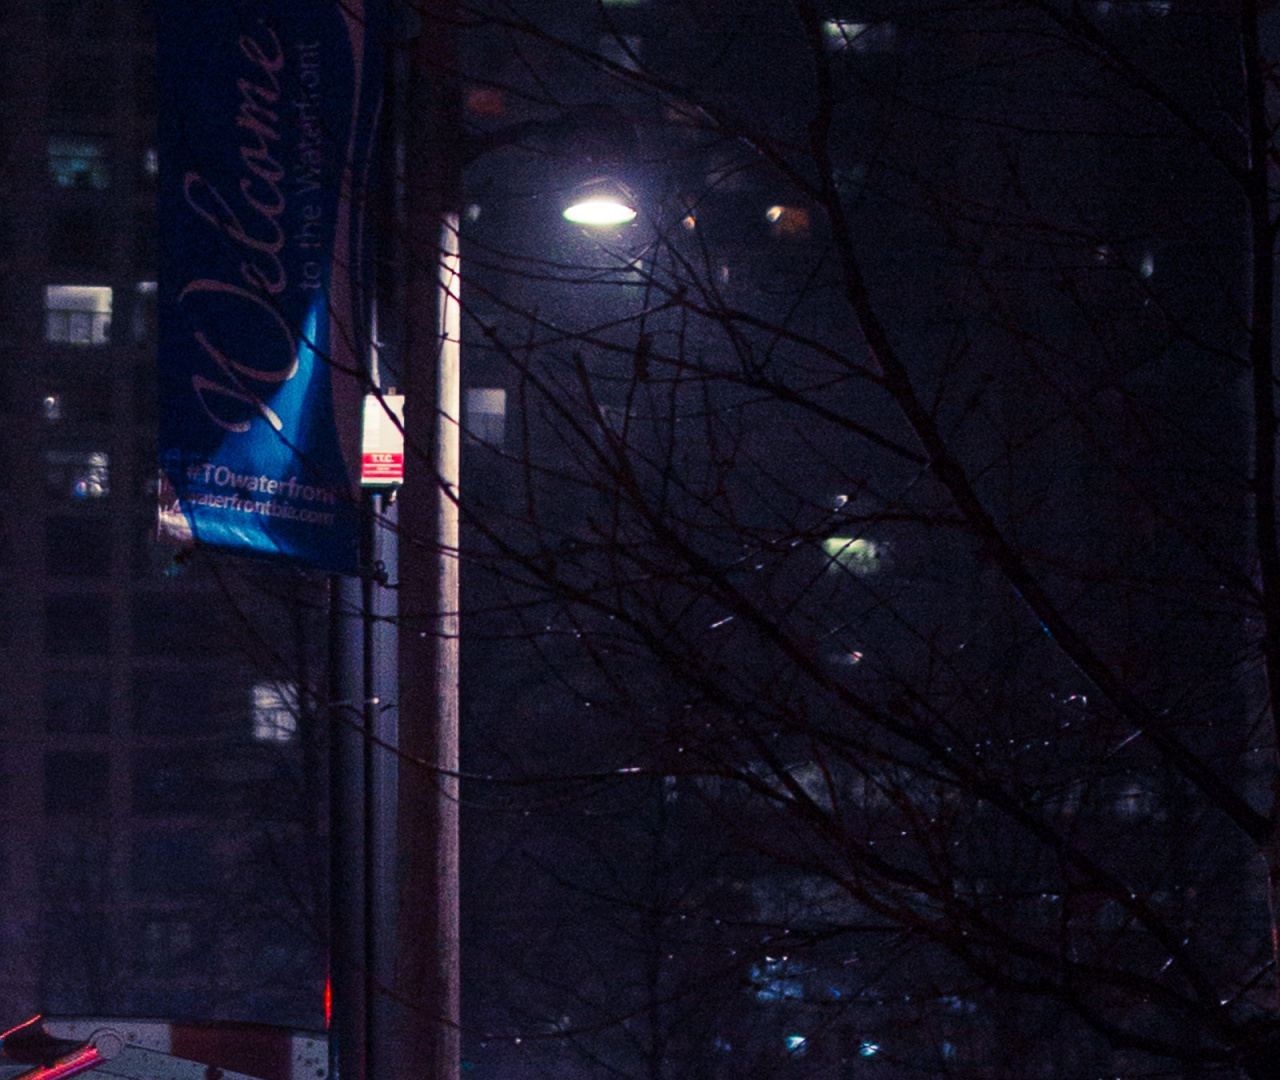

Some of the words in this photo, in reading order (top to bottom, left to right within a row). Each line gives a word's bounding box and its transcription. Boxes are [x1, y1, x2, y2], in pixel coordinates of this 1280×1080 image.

[292, 40, 322, 195] Waterfront
[178, 19, 298, 433] Welcome
[295, 205, 321, 249] the
[298, 261, 321, 291] to
